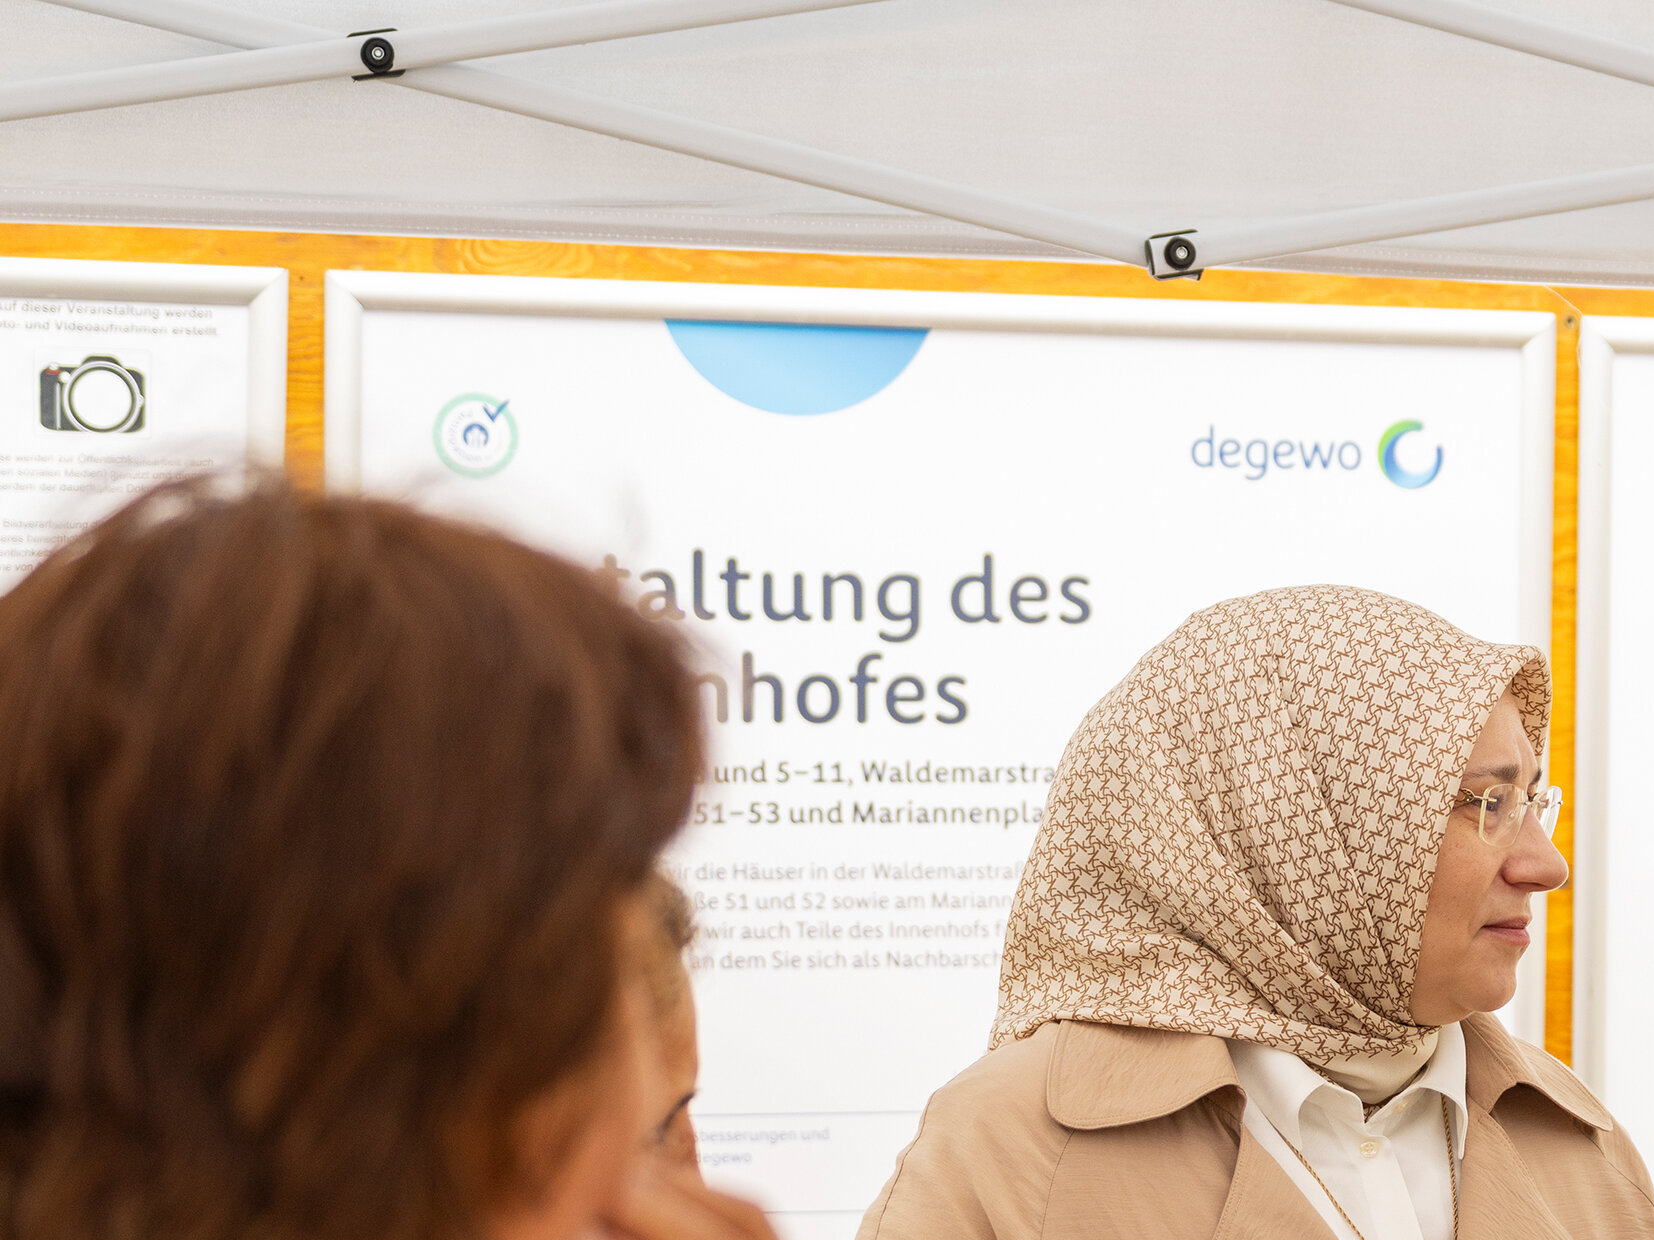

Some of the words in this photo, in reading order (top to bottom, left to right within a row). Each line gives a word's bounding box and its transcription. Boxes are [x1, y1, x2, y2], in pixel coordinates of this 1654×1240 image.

[22, 302, 61, 314] dieser
[67, 303, 159, 319] Veranstaltung
[165, 306, 213, 318] werden
[25, 320, 50, 331] und
[55, 320, 167, 334] Videoaufnahmen
[1191, 423, 1361, 481] degewo
[949, 552, 1094, 624] des
[714, 760, 766, 784] und
[790, 801, 842, 825] und
[695, 862, 728, 881] die
[733, 862, 805, 881] Häuser
[810, 862, 829, 881] in
[834, 862, 867, 881] der
[756, 892, 796, 911] und
[832, 892, 888, 910] sowie
[895, 895, 925, 909] am
[741, 921, 791, 940] auch
[797, 920, 844, 940] Teile
[849, 920, 883, 939] des
[889, 919, 989, 938] Innenhofs
[720, 950, 767, 970] dem
[772, 949, 801, 969] Sie
[807, 949, 845, 969] sich
[851, 949, 881, 968] als
[801, 1126, 831, 1142] und
